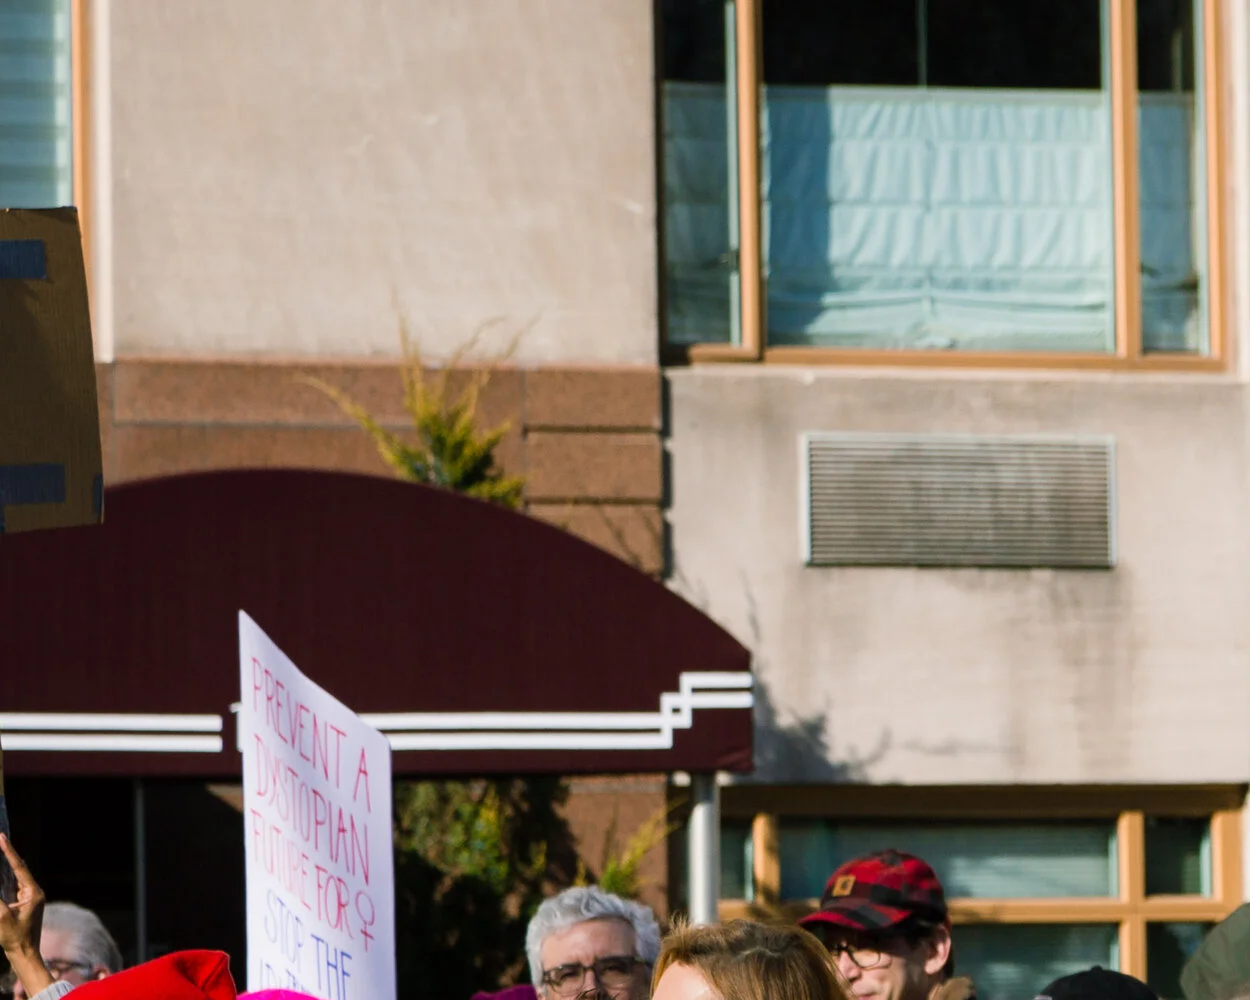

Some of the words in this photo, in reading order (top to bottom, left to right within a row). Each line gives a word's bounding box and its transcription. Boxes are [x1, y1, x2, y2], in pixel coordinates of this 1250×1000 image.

[251, 656, 347, 790] PREVENT
[353, 746, 371, 814] A
[254, 733, 370, 887] DYSTOPIAN
[264, 888, 304, 972] STOP
[315, 864, 355, 940] FOR
